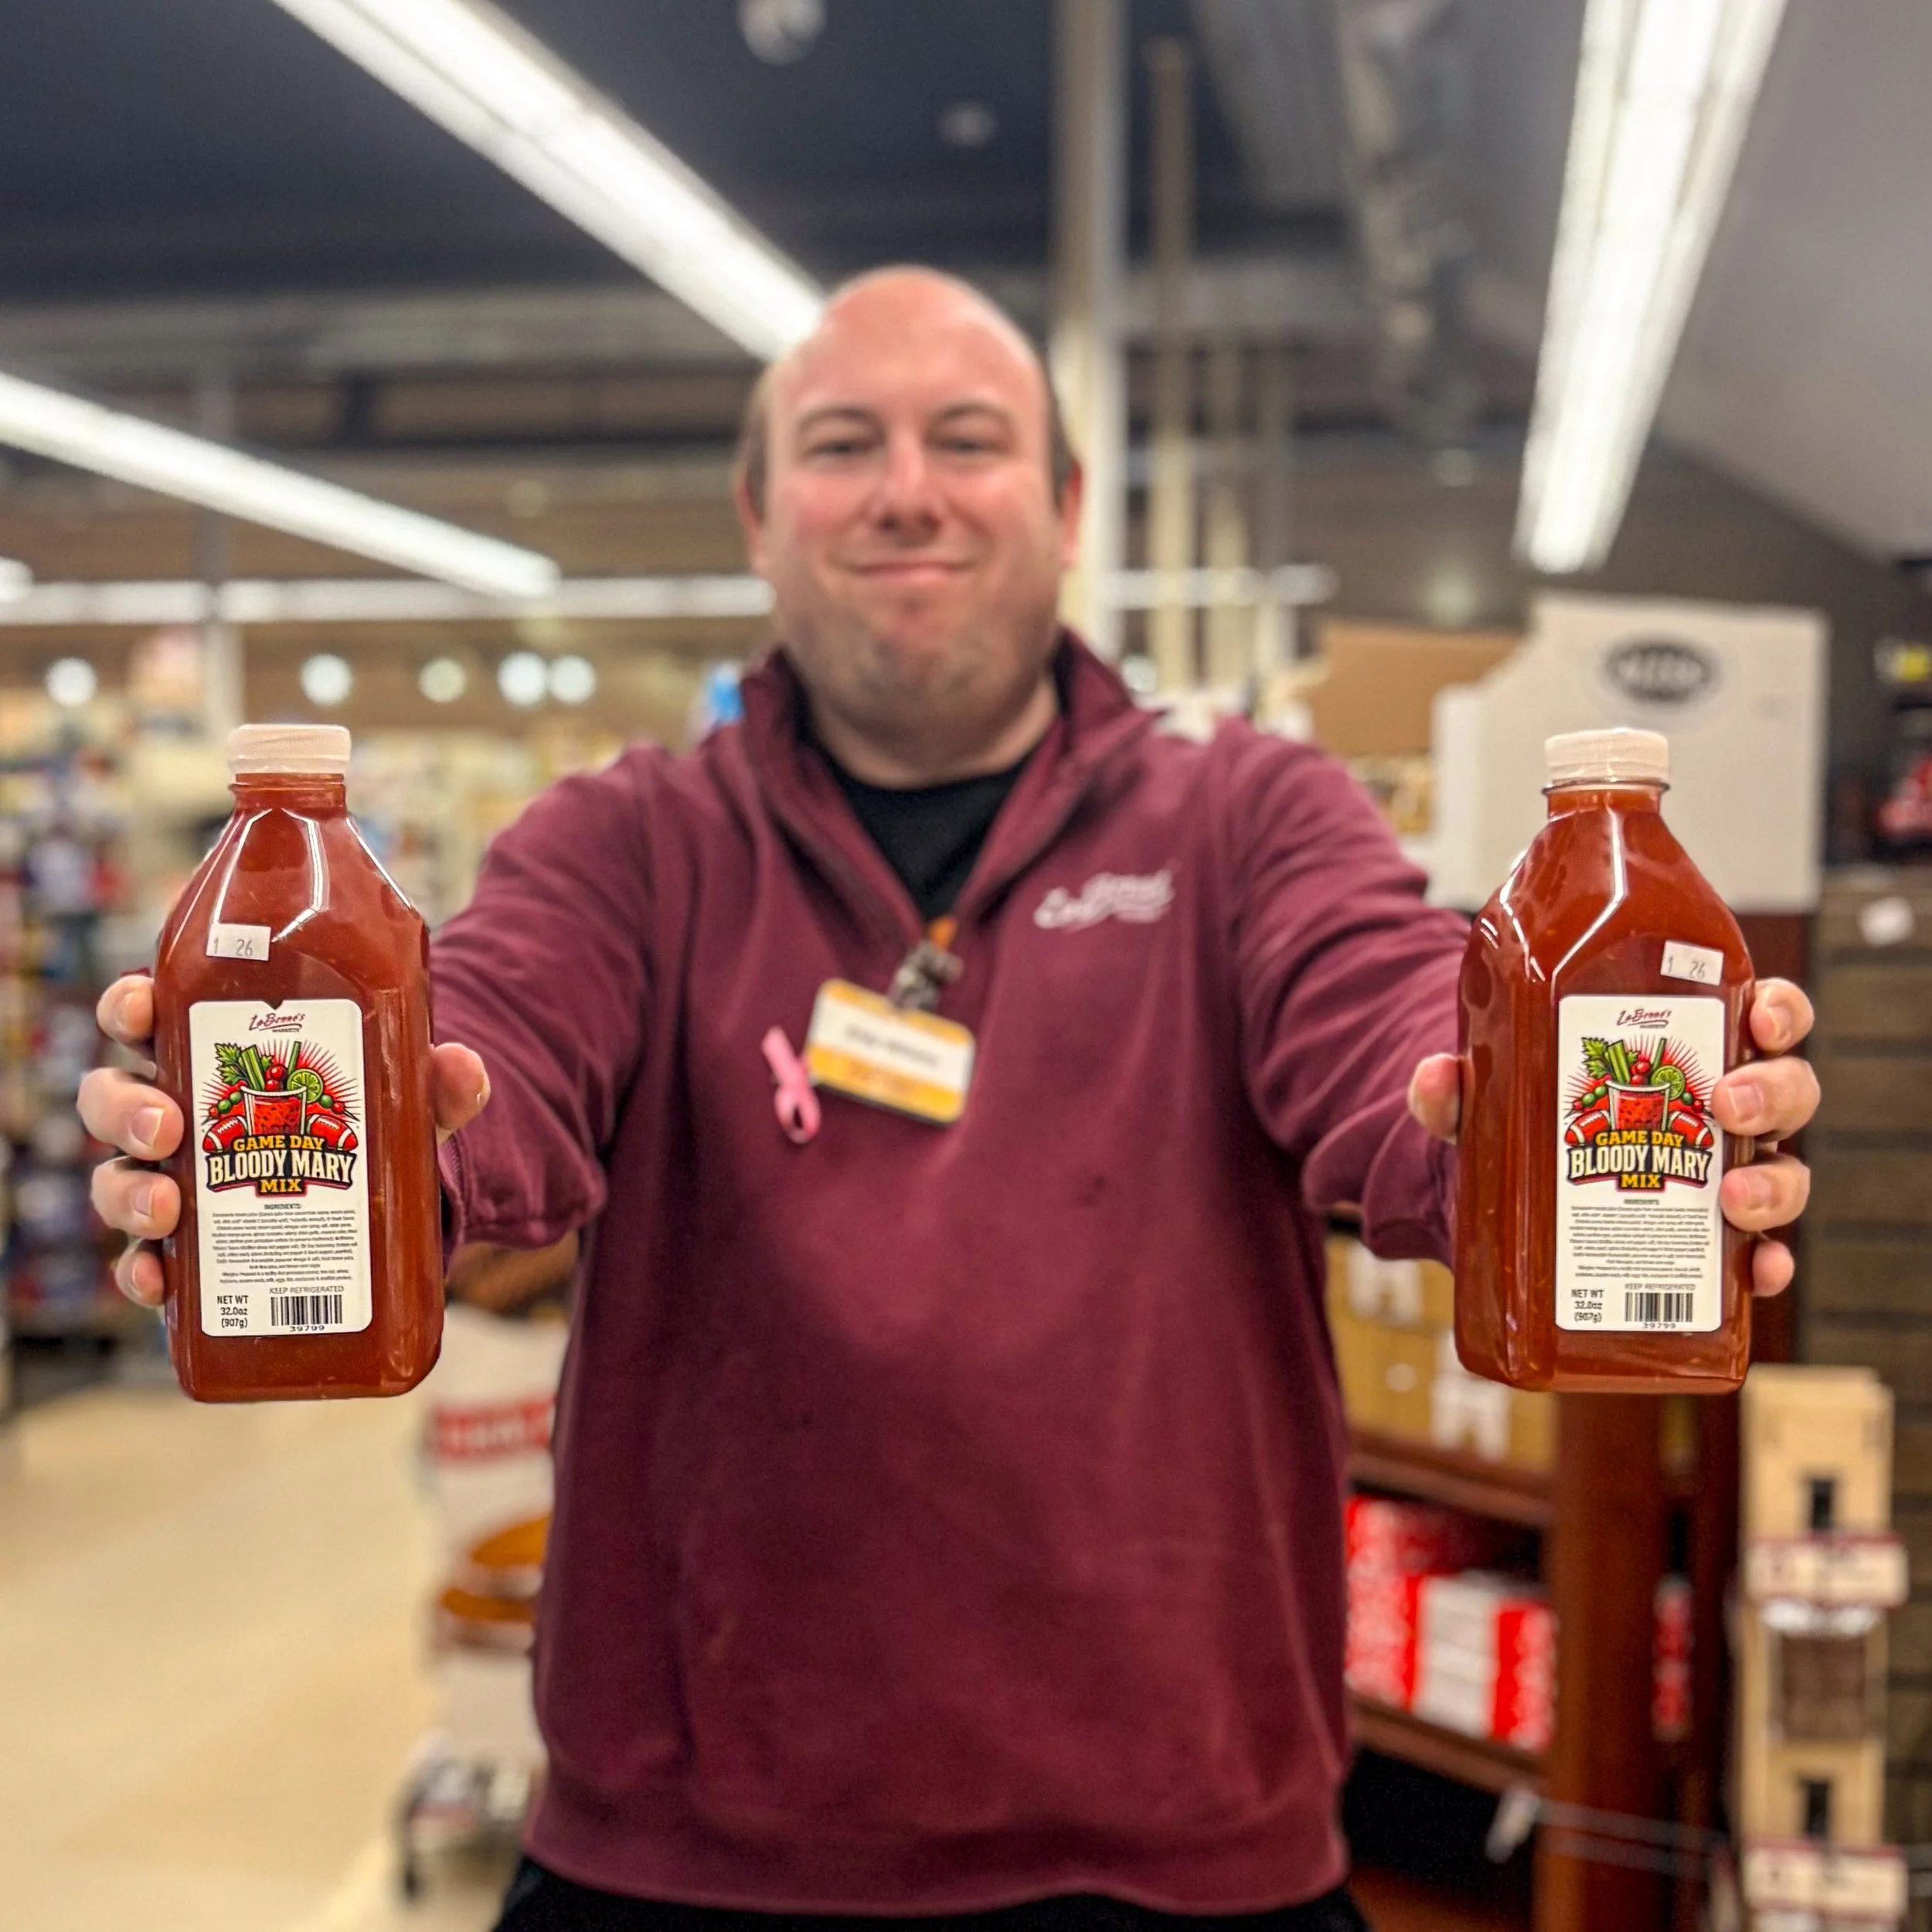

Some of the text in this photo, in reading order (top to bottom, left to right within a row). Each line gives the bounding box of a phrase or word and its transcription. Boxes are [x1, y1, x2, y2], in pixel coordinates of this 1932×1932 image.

[236, 939, 253, 957] 26
[1689, 961, 1706, 979] 26
[233, 1135, 325, 1151] GAME DAY
[1595, 1131, 1684, 1147] GAME DAY
[209, 1149, 355, 1185] BLOODY MARY
[1570, 1145, 1709, 1182] BLOODY MARY
[260, 1179, 301, 1192] MIX
[1621, 1174, 1662, 1188] MIX
[290, 1285, 345, 1294] REFRIGERATED
[1571, 1289, 1604, 1298] NET WT
[234, 1295, 248, 1304] WT
[220, 1307, 248, 1315] 32.0oz
[221, 1318, 248, 1328] (907g)
